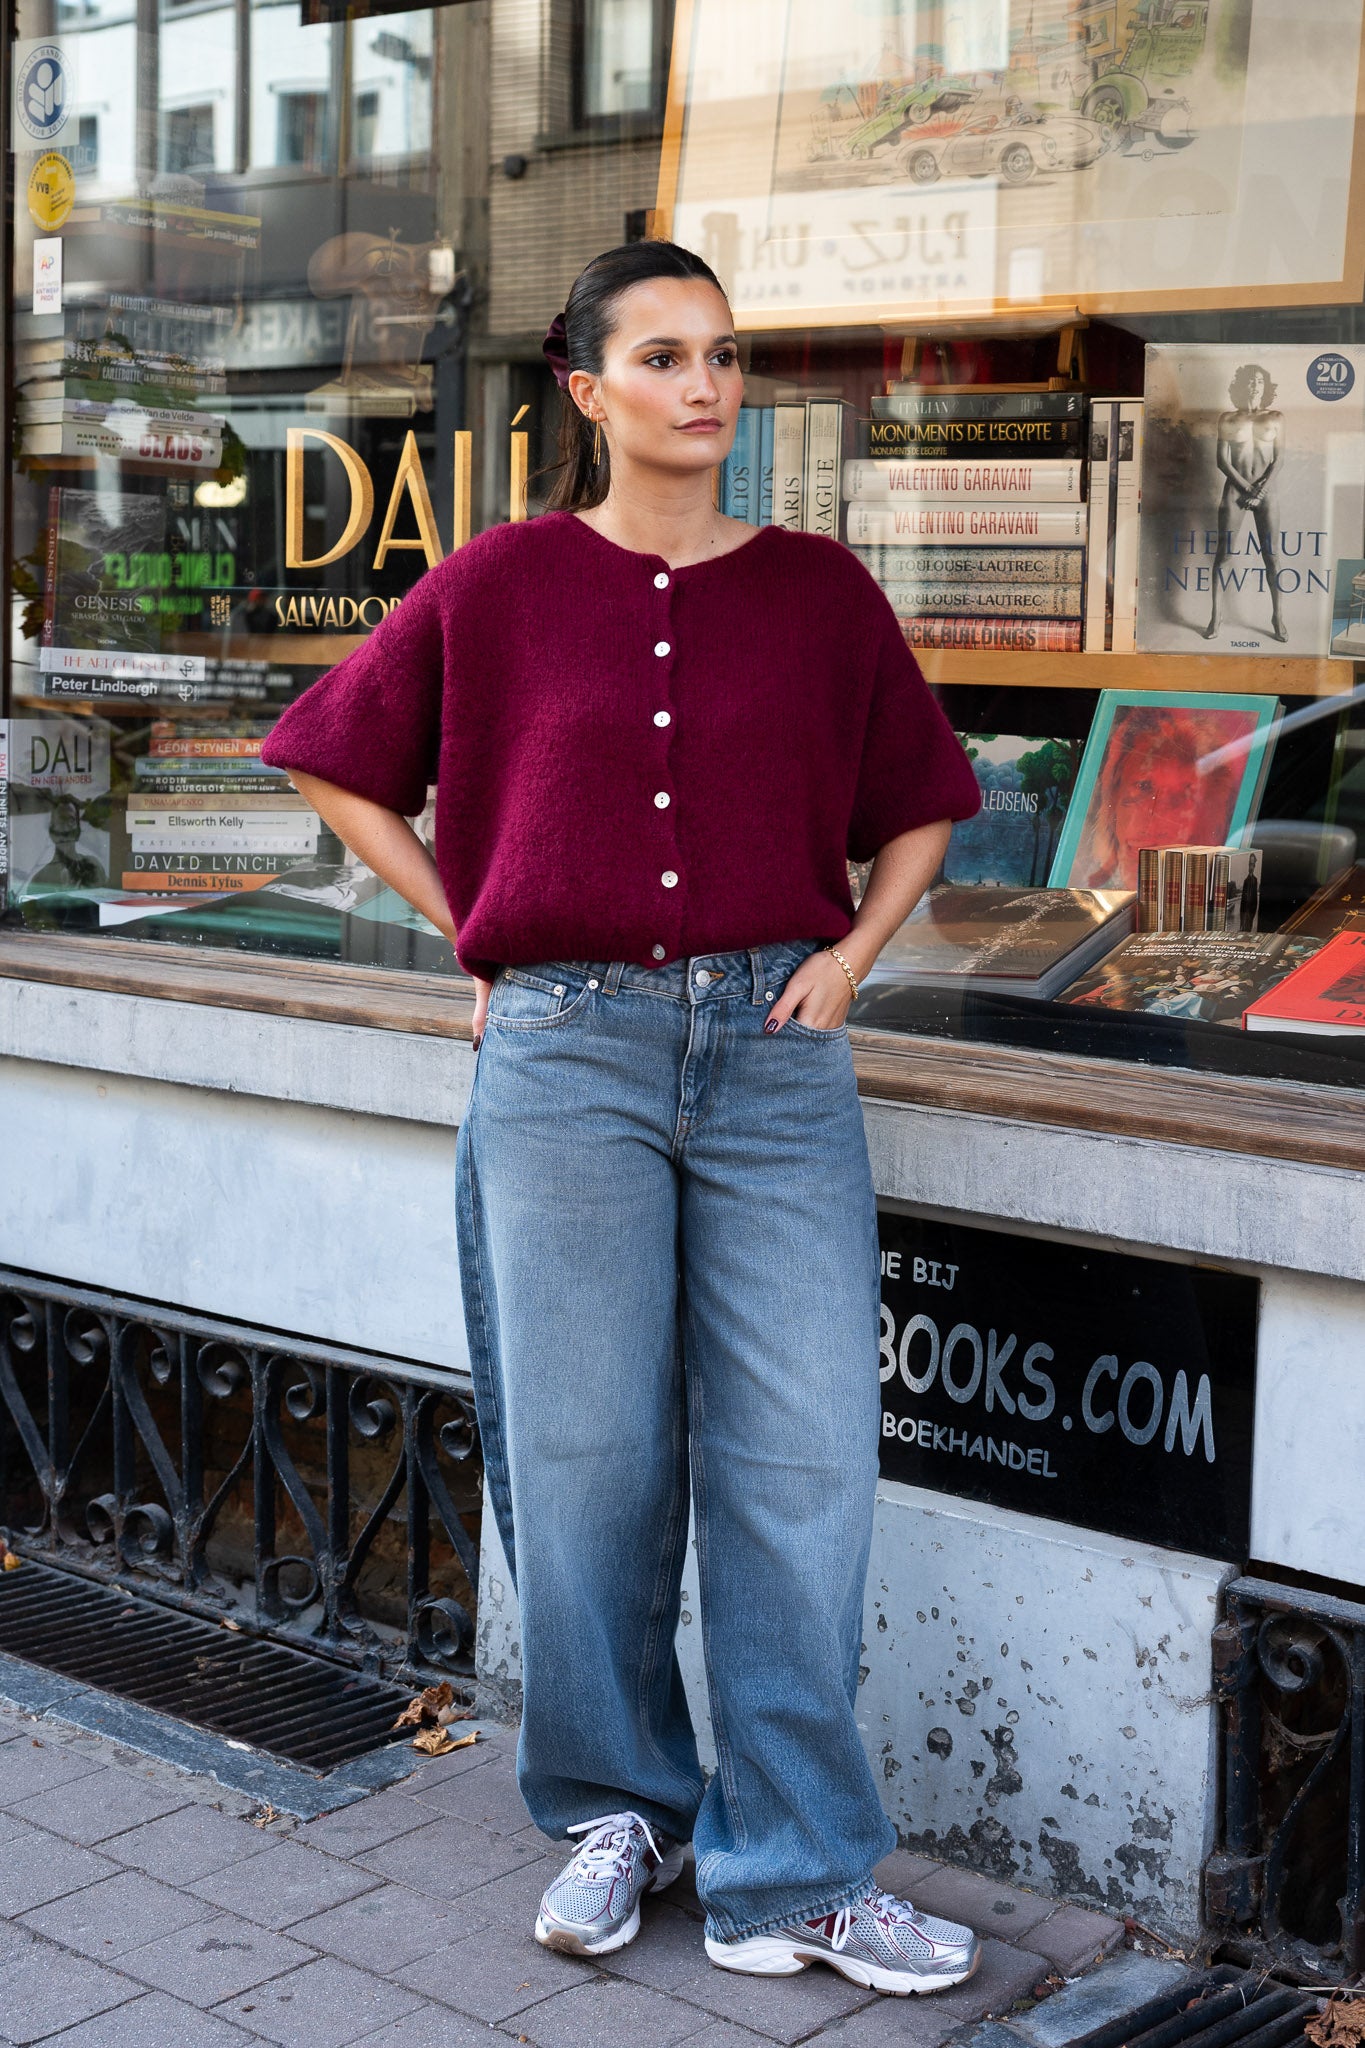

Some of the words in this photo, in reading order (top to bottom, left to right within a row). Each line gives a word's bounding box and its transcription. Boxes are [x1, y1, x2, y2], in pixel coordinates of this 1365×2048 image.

[35, 181, 50, 195] VVB
[36, 286, 60, 295] ANTWERP
[1317, 362, 1348, 383] 20
[120, 406, 142, 416] Sofie
[143, 408, 158, 418] Van
[159, 410, 170, 420] de
[171, 411, 194, 422] Velde
[899, 400, 950, 414] ITALIAN
[871, 423, 963, 442] MONUMENTS
[967, 423, 986, 441] DE
[990, 422, 1052, 441] L'EGYPTE
[139, 433, 203, 462] CLAUS
[871, 447, 912, 456] MONUMENTS
[286, 404, 530, 570] DALÍ
[889, 468, 958, 491] VALENTINO
[964, 468, 1032, 491] GARAVANI
[895, 511, 964, 534] VALENTINO
[970, 511, 1039, 534] GARAVANI
[1173, 530, 1328, 557] HELMUT
[1163, 567, 1332, 594] NEWTON
[74, 594, 143, 612] GENESIS
[940, 627, 1037, 647] BUILDINGS
[64, 655, 85, 668] THE
[52, 677, 89, 691] Peter
[91, 679, 158, 698] Lindbergh
[194, 743, 239, 753] STYNEN
[31, 776, 41, 785] EN
[43, 776, 62, 785] NIETS
[64, 774, 93, 785] ANDERS
[169, 784, 225, 792] BOURGEOIS
[169, 816, 216, 827] Ellsworth
[219, 816, 244, 829] Kelly
[134, 855, 201, 871] DAVID
[212, 856, 277, 872] LYNCH
[167, 875, 208, 887] Dennis
[210, 876, 243, 889] Tyfus
[1335, 1009, 1365, 1019] D
[913, 1256, 960, 1290] BIJ
[883, 1411, 1058, 1478] BOEKHANDEL
